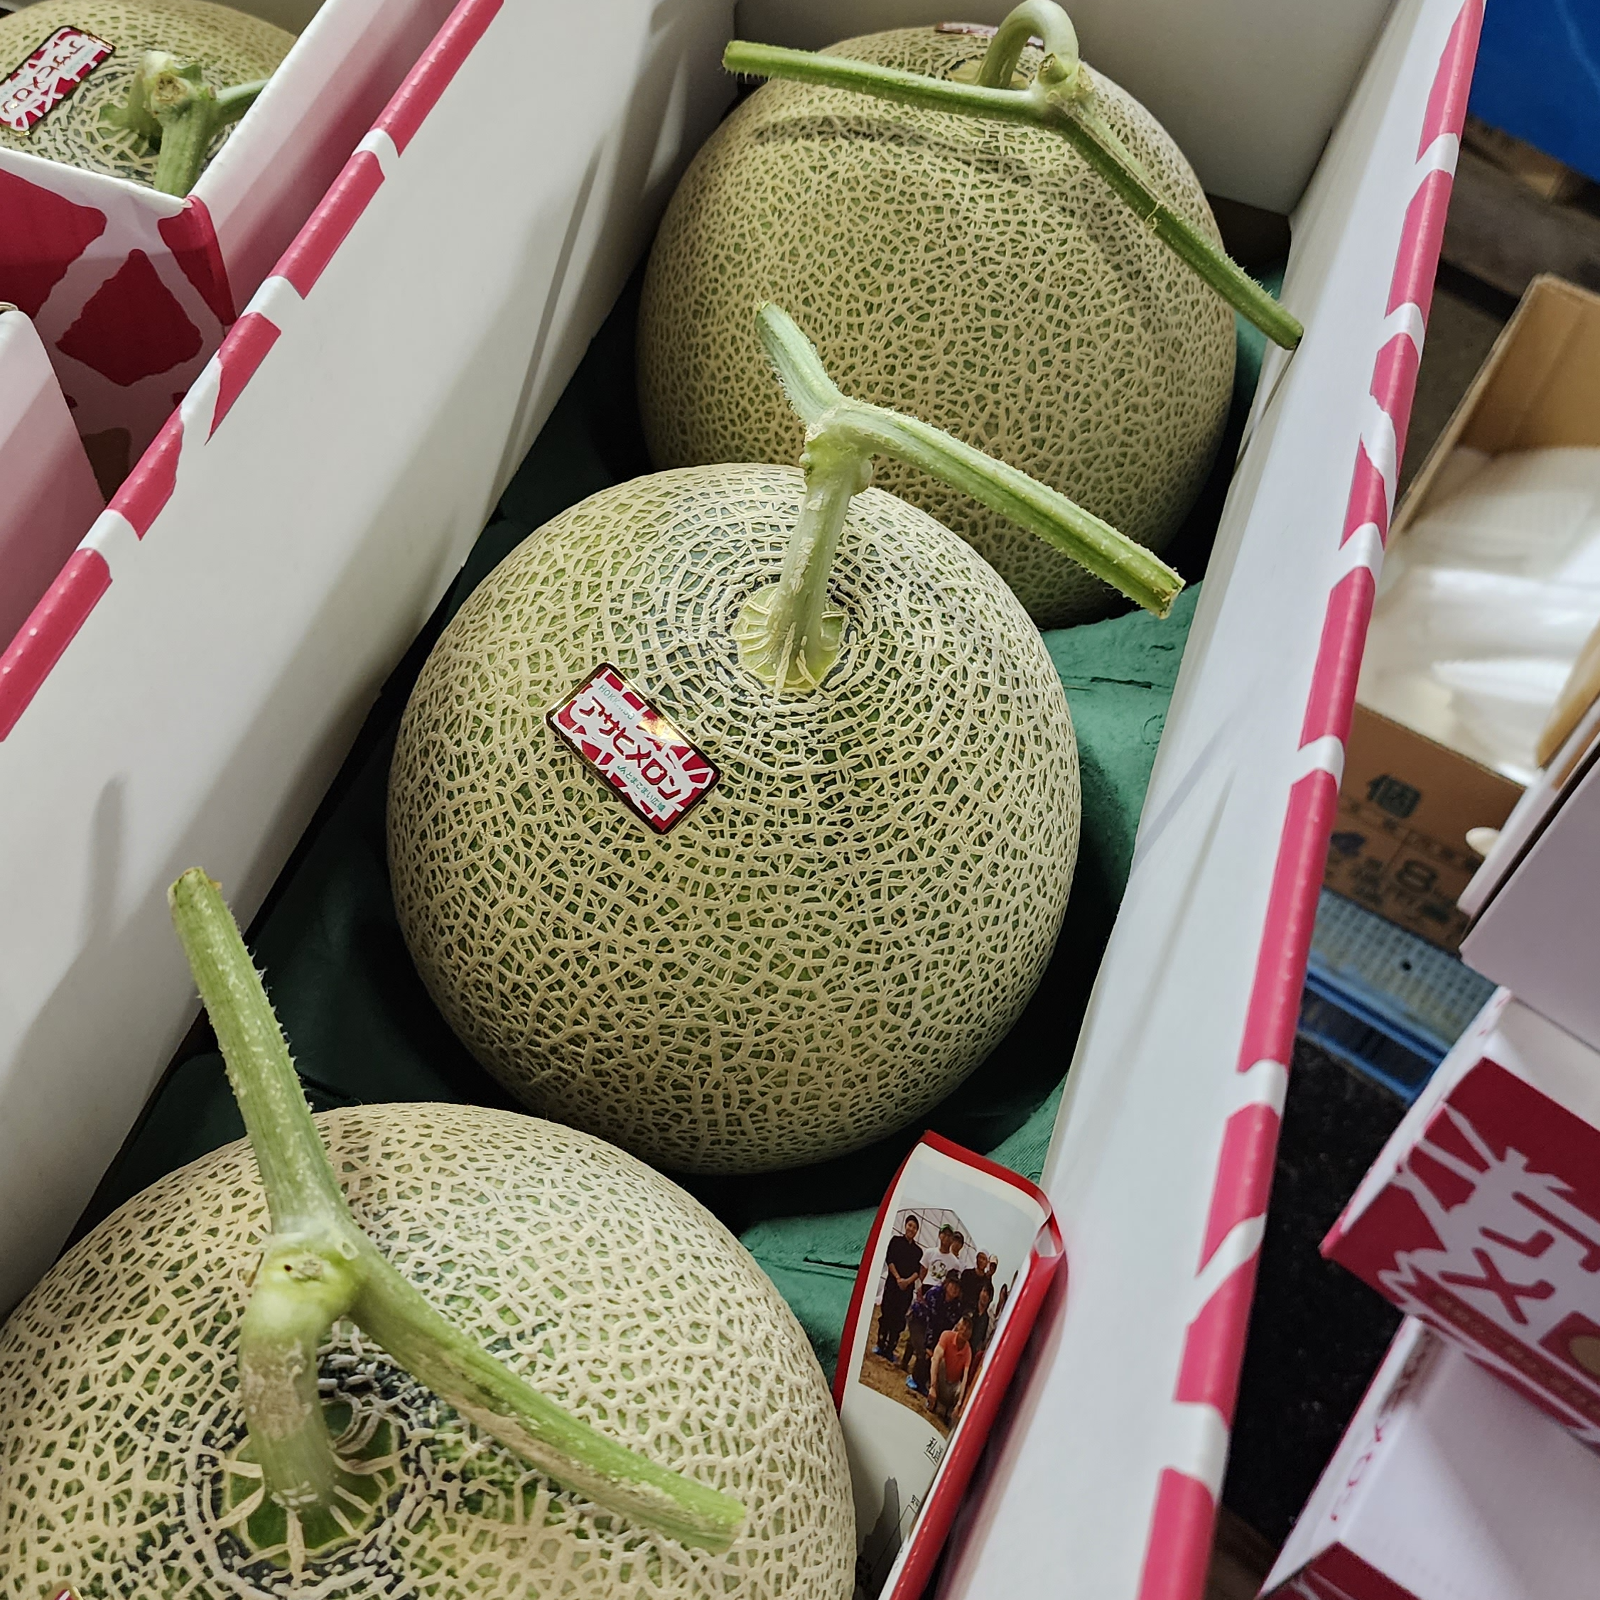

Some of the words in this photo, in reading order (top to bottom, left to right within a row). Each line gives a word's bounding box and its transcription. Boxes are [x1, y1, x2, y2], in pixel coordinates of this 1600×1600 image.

[578, 695, 683, 800] アサヒメロン
